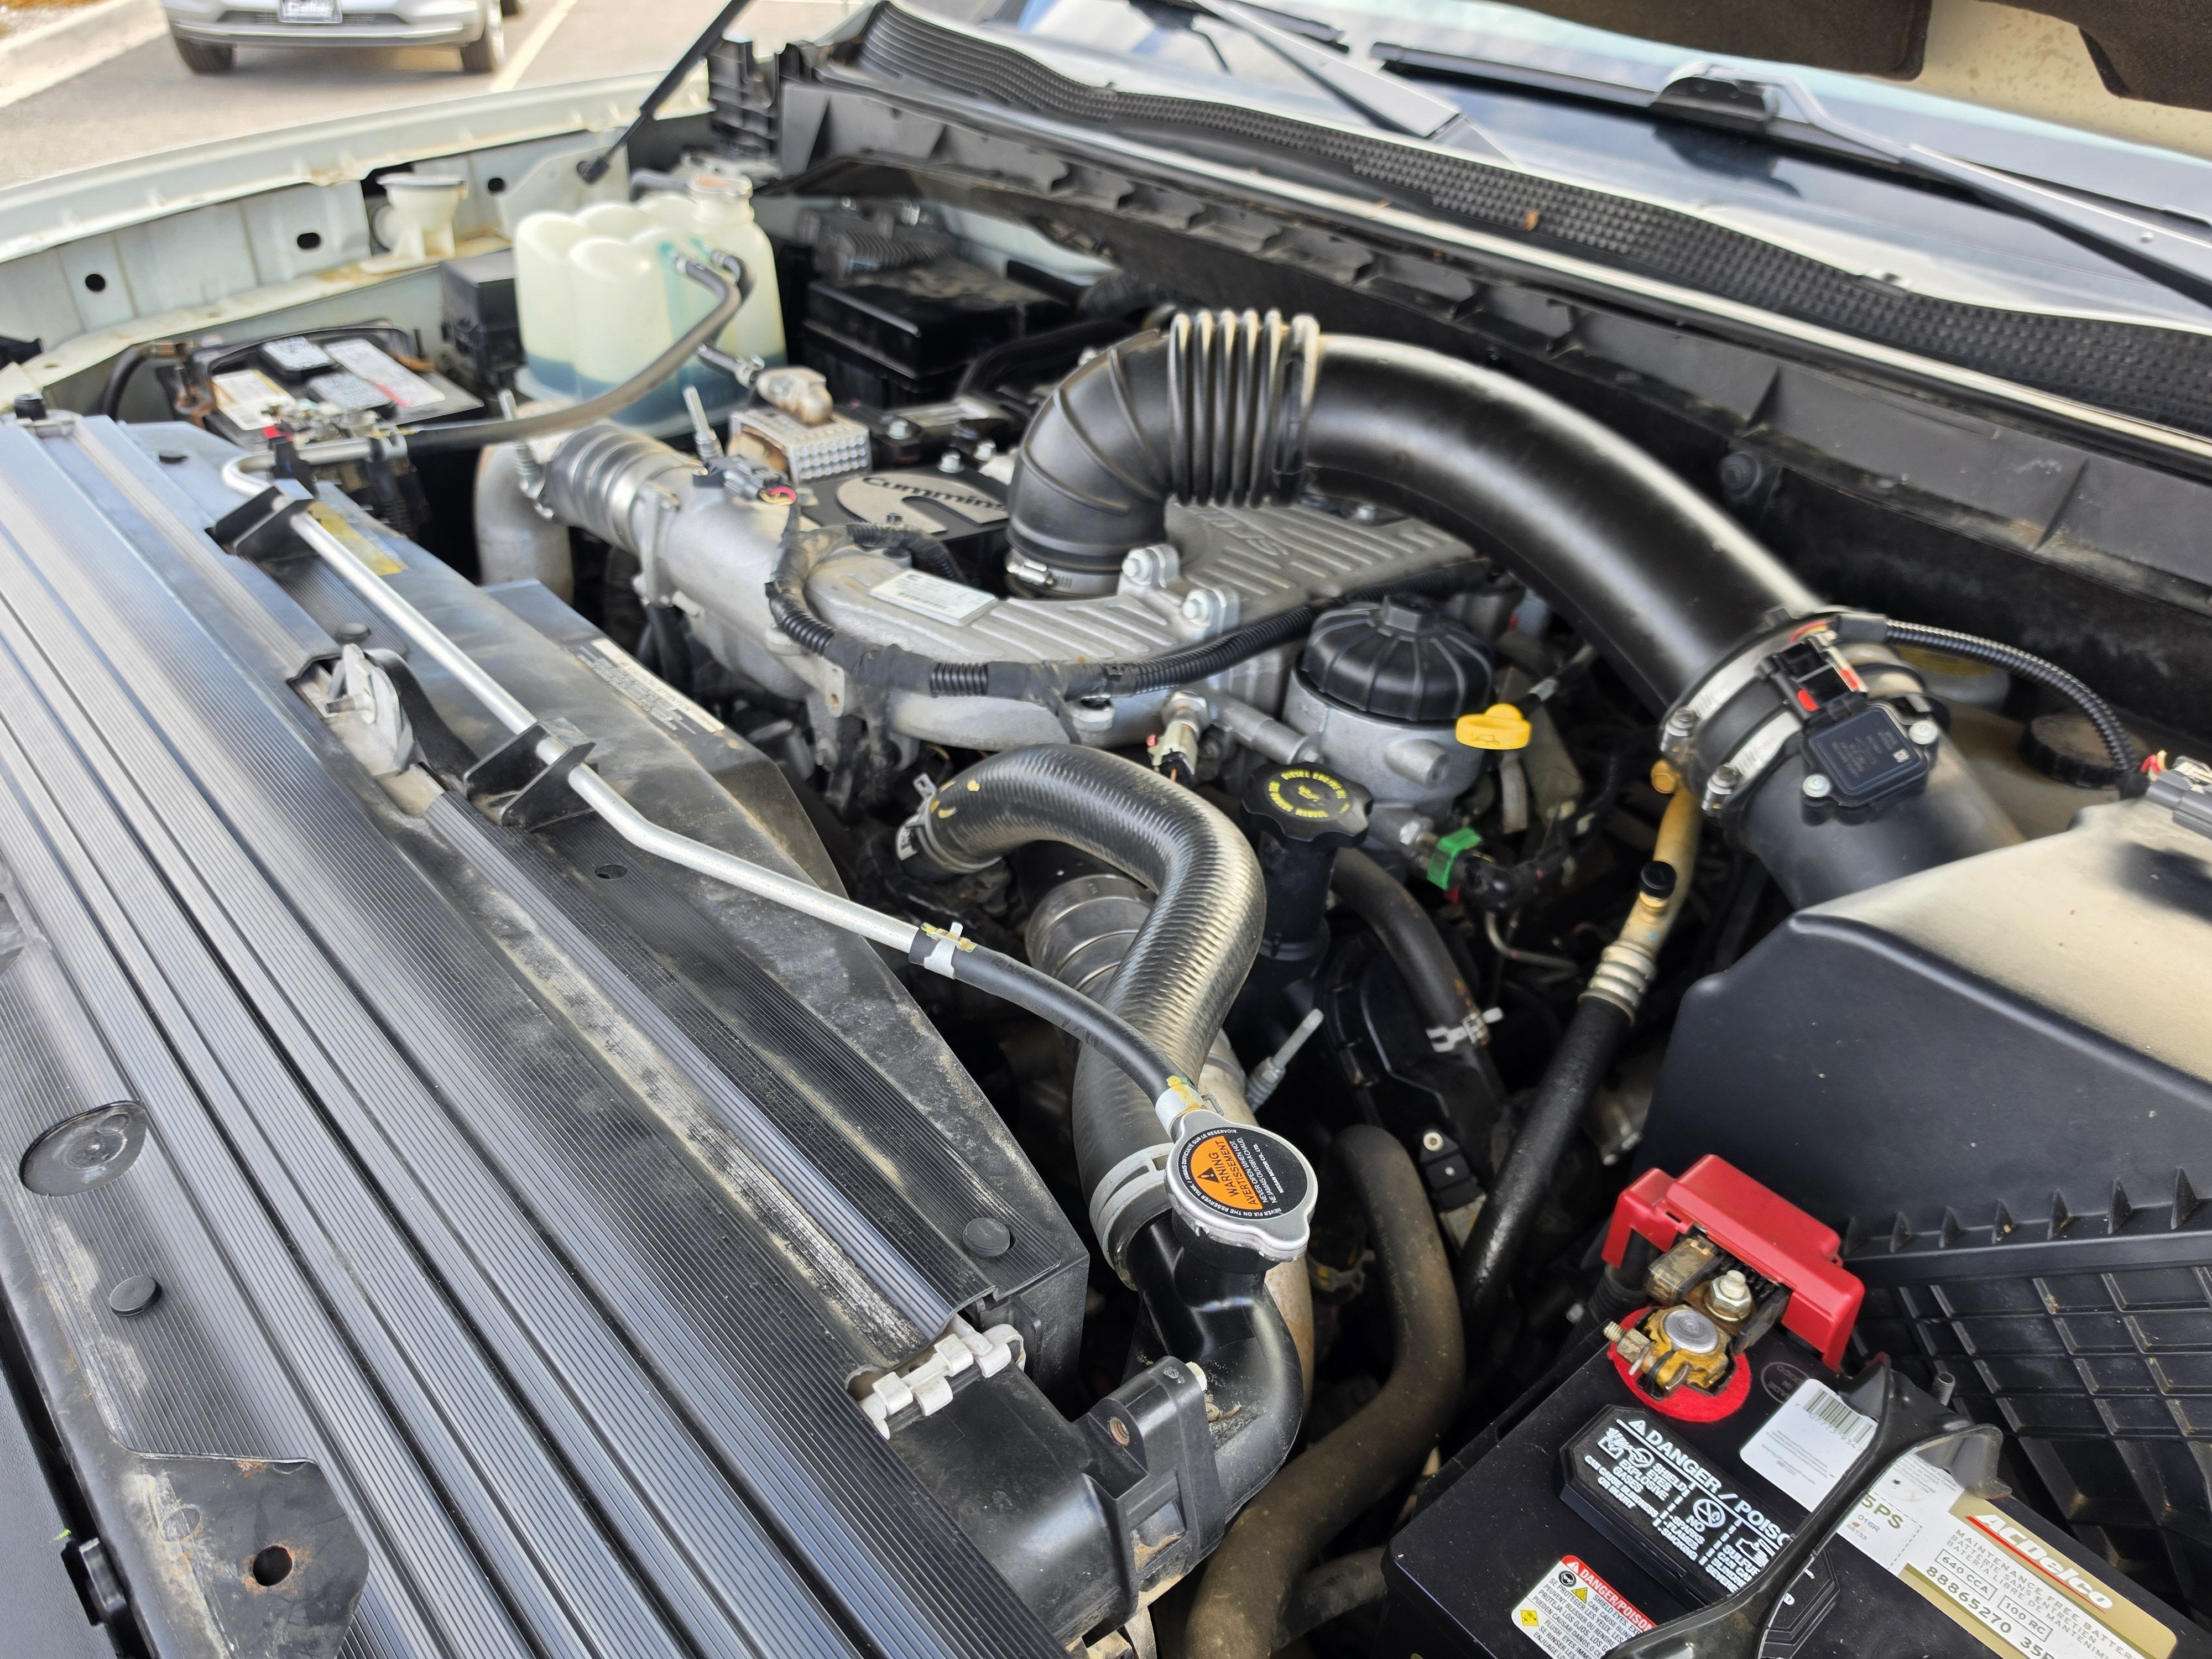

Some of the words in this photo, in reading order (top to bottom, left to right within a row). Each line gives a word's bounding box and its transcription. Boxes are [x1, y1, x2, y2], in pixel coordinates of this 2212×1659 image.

[863, 476, 1006, 510] Cummins
[1281, 769, 1310, 780] DIESEL
[1312, 771, 1343, 791] ENGINE
[1208, 1152, 1239, 1197] WARNING
[1215, 1140, 1258, 1204] AVERTISSEMENT
[1235, 1150, 1249, 1168] WHEN
[1245, 1168, 1258, 1184] OPEN
[1262, 1161, 1275, 1177] MOTOR
[1254, 1184, 1269, 1203] NEVER
[1271, 1176, 1284, 1193] NISSAN
[1584, 1454, 1601, 1470] CAN
[1598, 1467, 1623, 1489] CAUSE
[1620, 1484, 1659, 1518] BLINDNESS
[1597, 1476, 1611, 1489] OR
[1608, 1485, 1636, 1509] INJURY
[1613, 1466, 1644, 1493] GASES
[1619, 1459, 1669, 1501] EXPLOSIVE
[1646, 1469, 1672, 1491] EYES
[1646, 1430, 1721, 1493] DANGER
[1734, 1500, 1790, 1546] POISO
[1652, 1463, 1687, 1494] SHIELD
[1685, 1515, 1705, 1532] NO
[1861, 1494, 1904, 1529] 5PS
[1717, 1551, 1736, 1569] CAN
[1942, 1556, 1964, 1574] 640
[1966, 1574, 1987, 1594] CCA
[1949, 1534, 2001, 1573] BATTERIE
[2003, 1573, 2032, 1596] SANS
[1976, 1515, 2112, 1608] ACDelco
[1548, 1577, 1559, 1587] SE
[1556, 1584, 1586, 1611] PROTEGER
[1584, 1608, 1597, 1620] LES
[1595, 1616, 1612, 1634] YEUX.
[1611, 1631, 1624, 1644] LES
[1593, 1594, 1614, 1614] SHIELD
[1612, 1611, 1629, 1626] EYES.
[1946, 1540, 1991, 1575] BATERÍA
[1992, 1574, 2025, 1600] LIBRE
[2027, 1599, 2043, 1613] DE
[2046, 1612, 2104, 1658] MANTENIM
[1955, 1529, 2043, 1595] MAINTENANCE
[2047, 1595, 2080, 1622] FREE
[2083, 1621, 2132, 1659] BATTER
[1532, 1595, 1553, 1615] PUEDEN
[1552, 1613, 1573, 1632] CAUSAR
[1571, 1630, 1590, 1648] DAÑOS
[1537, 1589, 1563, 1613] PROTEJA
[1562, 1610, 1575, 1623] LOS
[1573, 1620, 1590, 1638] OJOS.
[1589, 1634, 1603, 1647] LOS
[1543, 1583, 1567, 1604] PEUVENT
[1564, 1603, 1588, 1624] BLESSER
[1586, 1621, 1596, 1630] OU
[1593, 1627, 1615, 1647] RENDRE
[1587, 1600, 1600, 1613] CAN
[1599, 1611, 1618, 1628] CAUSE
[1615, 1625, 1632, 1641] BLIND
[1923, 1566, 2011, 1633] 88865270
[2020, 1636, 2054, 1659] 35P
[2006, 1602, 2026, 1620] 100
[2028, 1619, 2046, 1635] RC
[1533, 1631, 1559, 1655] ENJUAGE
[1538, 1625, 1548, 1635] SE
[1546, 1632, 1566, 1651] RINSER
[1564, 1648, 1576, 1659] LES
[1544, 1619, 1562, 1636] FLUSH
[1562, 1635, 1577, 1649] EYES
